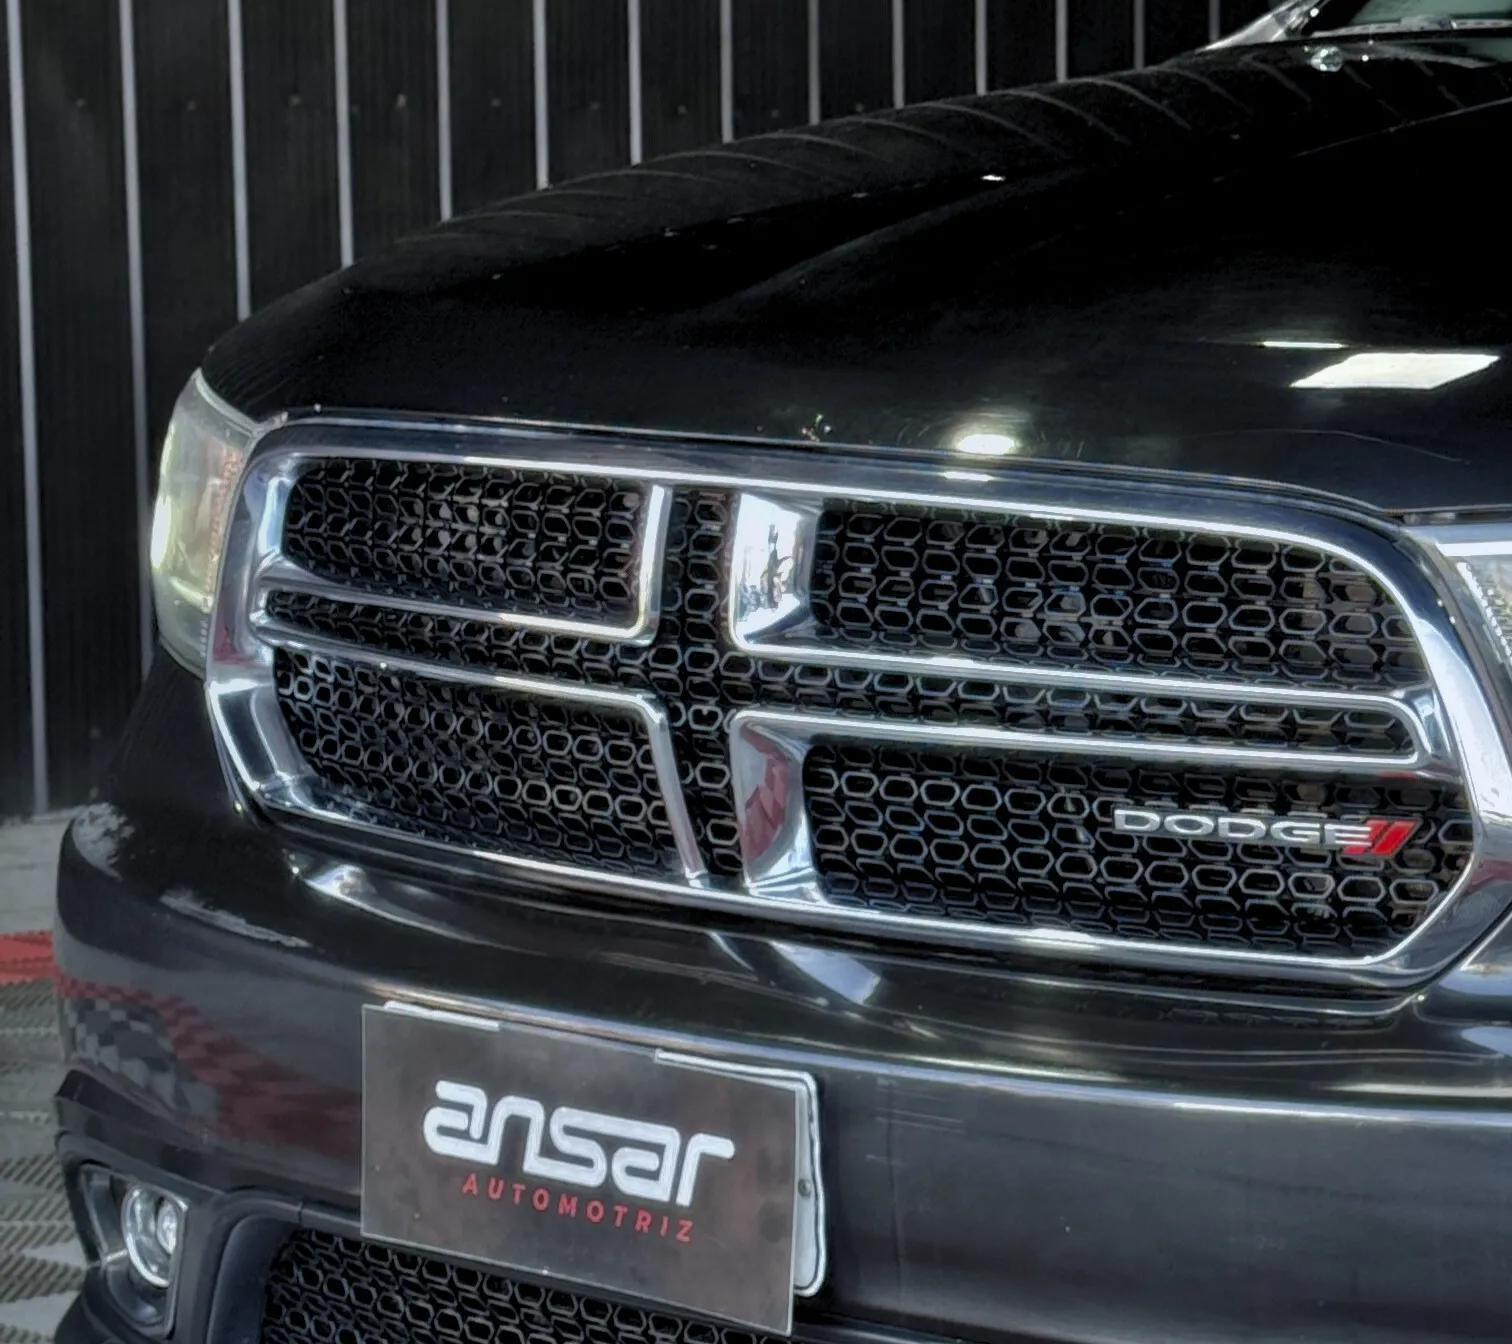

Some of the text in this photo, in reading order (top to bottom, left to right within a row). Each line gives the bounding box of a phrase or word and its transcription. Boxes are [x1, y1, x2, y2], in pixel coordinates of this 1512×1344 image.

[1114, 809, 1372, 847] DODGE
[423, 1080, 735, 1207] ansar
[461, 1172, 694, 1243] AUTOMOTRIZ
